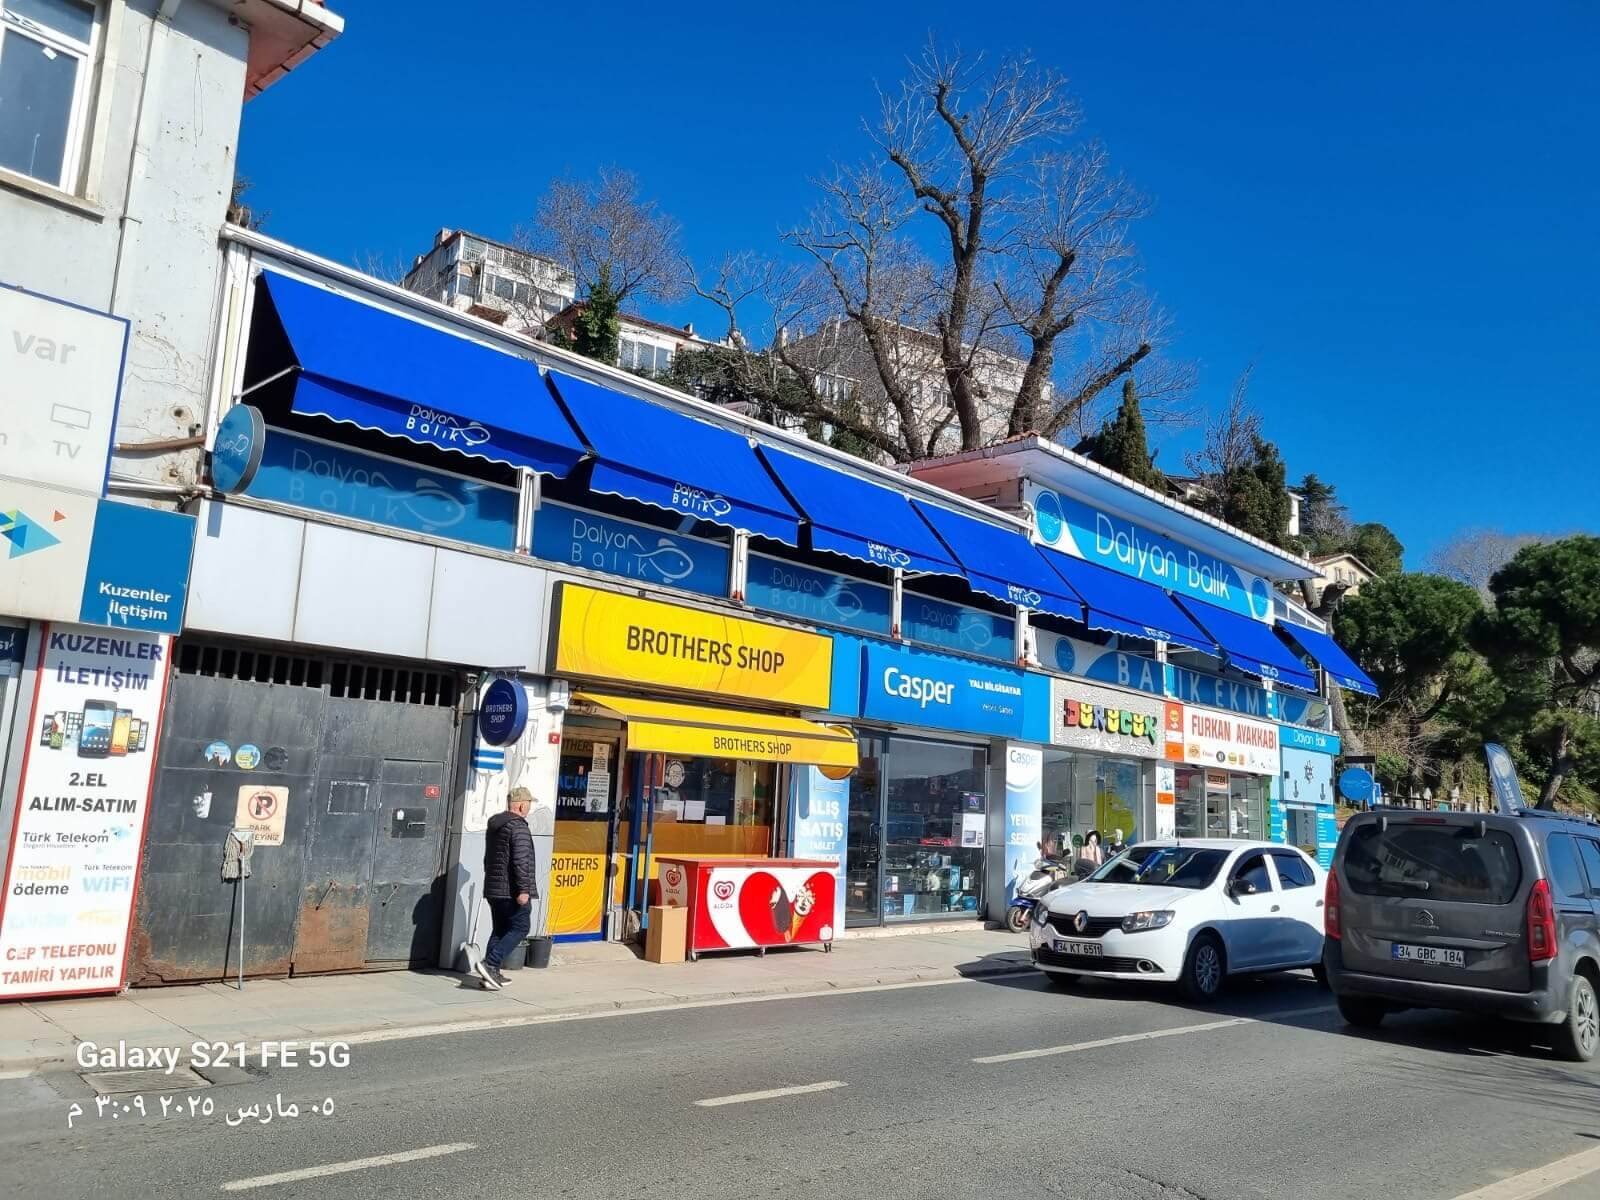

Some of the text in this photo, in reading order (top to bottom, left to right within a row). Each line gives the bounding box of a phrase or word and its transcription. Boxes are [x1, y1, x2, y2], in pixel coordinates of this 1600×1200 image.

[12, 329, 77, 365] var
[410, 403, 459, 428] Dalyan
[406, 417, 458, 442] Balık
[52, 440, 81, 460] TV
[291, 449, 394, 488] Dalyan
[289, 477, 399, 522] Balık
[674, 481, 708, 500] Dalyan
[573, 518, 646, 550] Dalyan
[571, 542, 650, 577] Balık
[1096, 512, 1179, 582] Dalyan
[1188, 551, 1231, 600] Balık
[773, 567, 826, 594] Dalyan
[99, 582, 171, 605] Kuzenler
[109, 600, 168, 622] İletişim
[50, 632, 163, 661] KUZENLER
[627, 625, 785, 674] BROTHERS SHOP
[57, 661, 148, 692] İLETİŞİM
[884, 667, 955, 708] Casper
[485, 704, 513, 713] BROTHERS
[1191, 714, 1277, 751] FURKAN AYAKKABI
[713, 736, 792, 755] BROTHERS SHOP
[69, 772, 107, 787] 2.EL
[29, 797, 137, 813] ALIM-SATIM
[23, 831, 109, 843] Türk Telekom
[551, 857, 599, 871] ROTHERS
[13, 883, 69, 895] ödeme
[555, 873, 585, 888] SHOP
[41, 944, 117, 959] TELEFONU
[1059, 943, 1067, 952] 34
[1070, 944, 1080, 953] KT
[1399, 946, 1462, 962] 34 GBC 184
[2, 966, 114, 984] TAMİRİ YAPILIR
